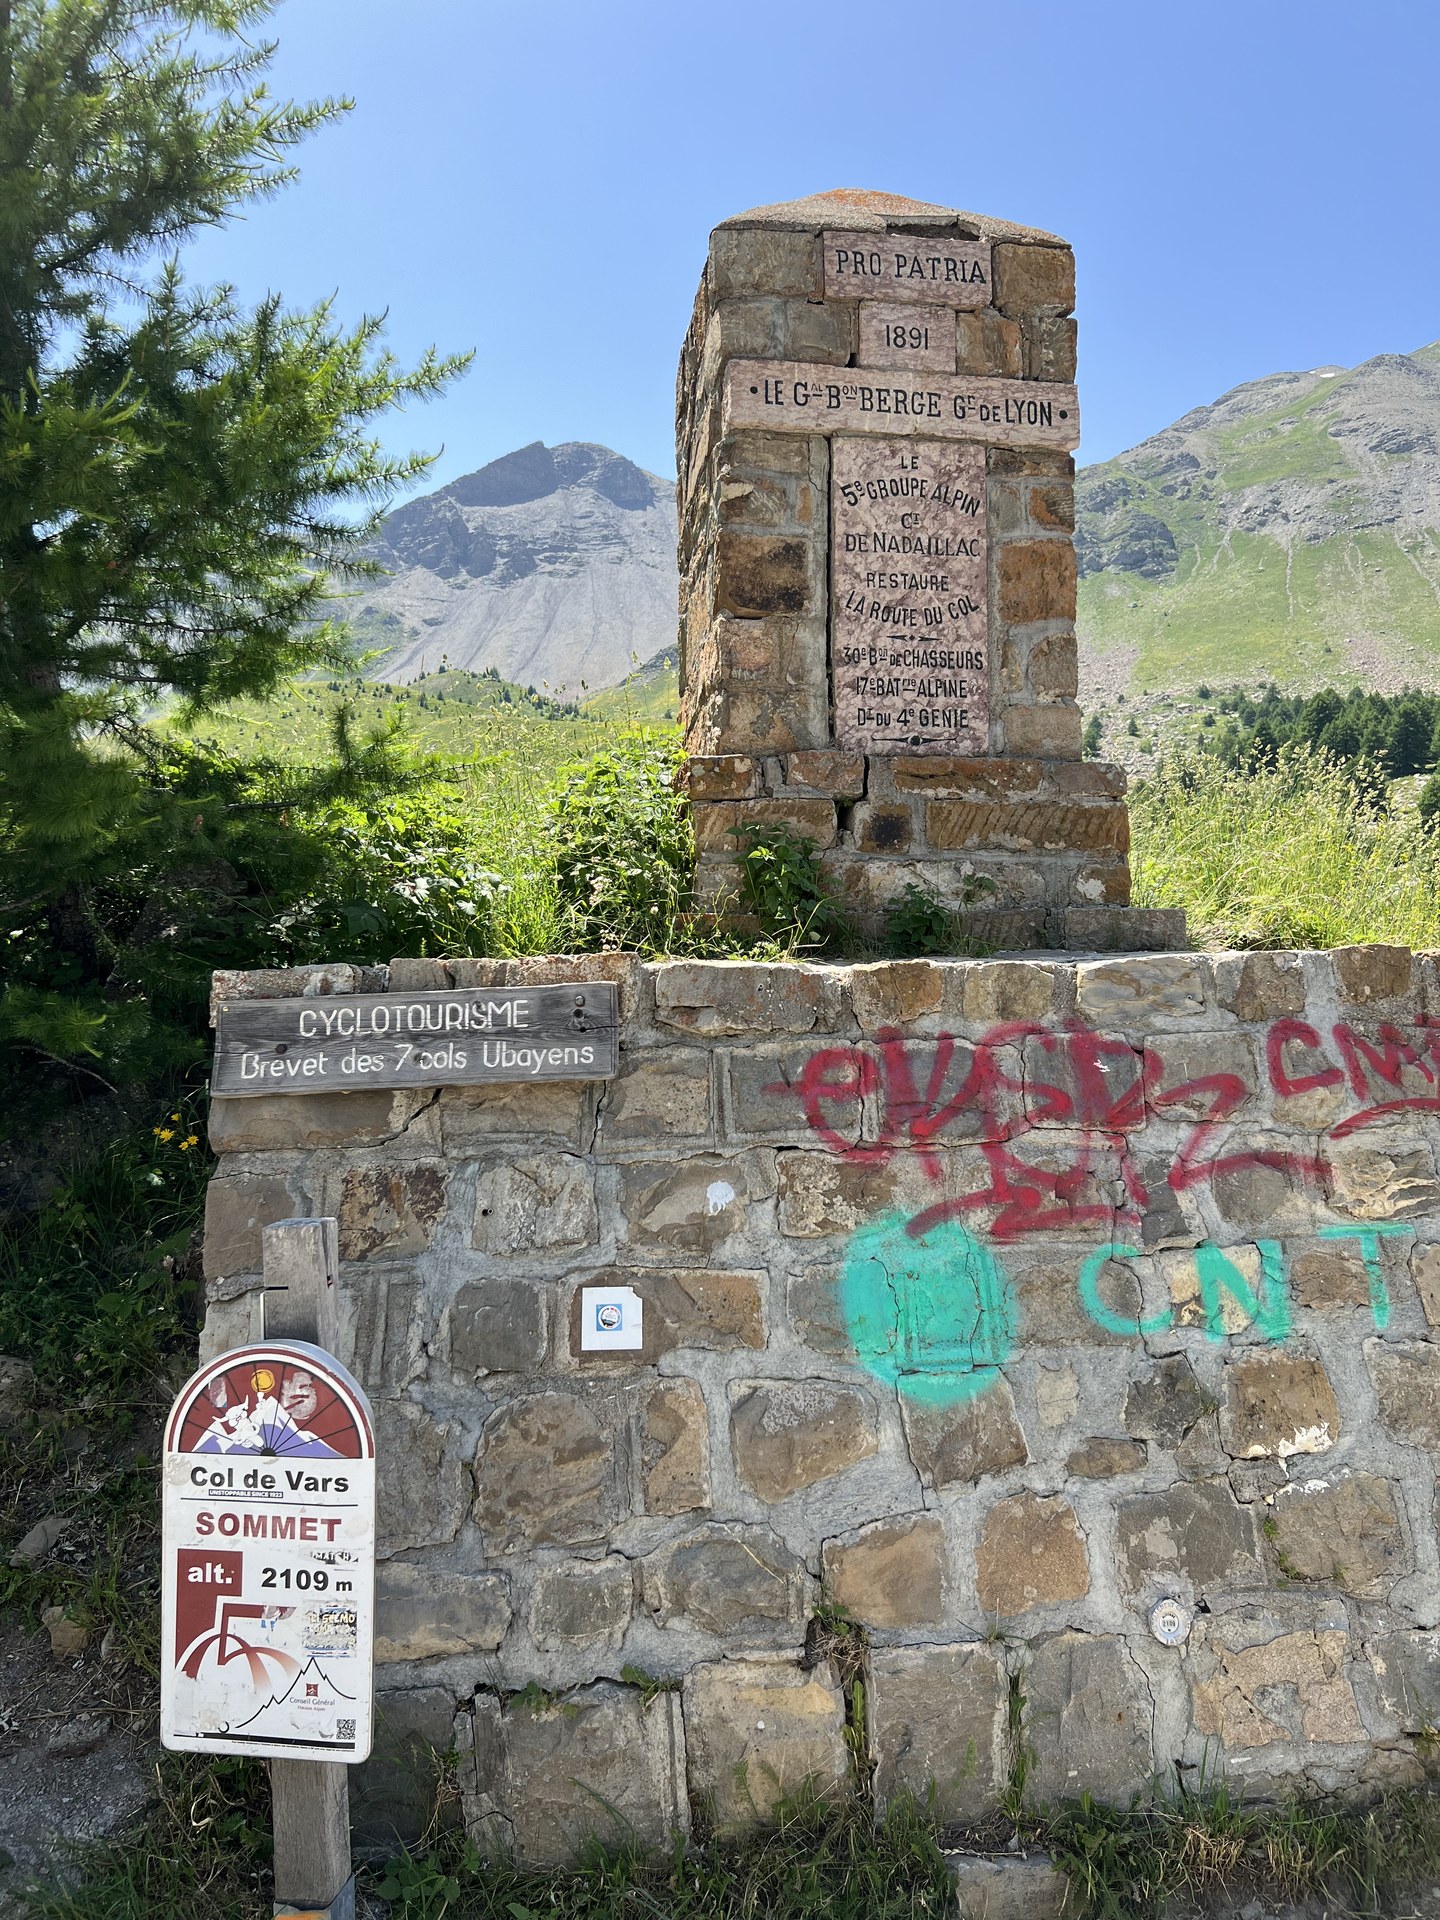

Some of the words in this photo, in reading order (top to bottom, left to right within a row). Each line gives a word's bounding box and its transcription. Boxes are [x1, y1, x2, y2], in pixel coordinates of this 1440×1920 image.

[835, 250, 882, 277] PRO
[894, 254, 987, 284] PATRIA
[886, 325, 929, 351] 1891
[764, 380, 784, 406] LE
[860, 387, 942, 418] BERGE
[980, 406, 1001, 423] DE
[1005, 399, 1053, 427] LYON
[901, 456, 919, 470] LE
[866, 477, 928, 501] GROUPE
[930, 483, 981, 518] ALPIN
[845, 533, 869, 553] DE
[873, 532, 981, 558] NADAILLAC
[866, 572, 950, 592] RESTAURE
[845, 590, 866, 615] LA
[869, 600, 918, 627] ROUTE
[924, 606, 943, 626] DU
[948, 594, 980, 620] COL
[903, 649, 984, 670] CHASSEURS
[917, 679, 968, 698] ALPINE
[876, 713, 891, 727] DU
[919, 709, 969, 728] GENIE
[299, 999, 530, 1038] CYCLOTOURISME
[241, 1050, 328, 1079] Brevet
[341, 1047, 385, 1074] des
[394, 1044, 415, 1072] 7
[418, 1042, 467, 1070] cols
[483, 1041, 594, 1075] Ubayens
[190, 1466, 234, 1488] Col
[243, 1469, 276, 1490] de
[285, 1470, 349, 1493] Vars
[195, 1511, 342, 1542] SOMMET
[187, 1563, 233, 1584] alt.
[261, 1567, 329, 1592] 2109
[335, 1580, 353, 1592] m
[290, 1697, 311, 1705] Conseil
